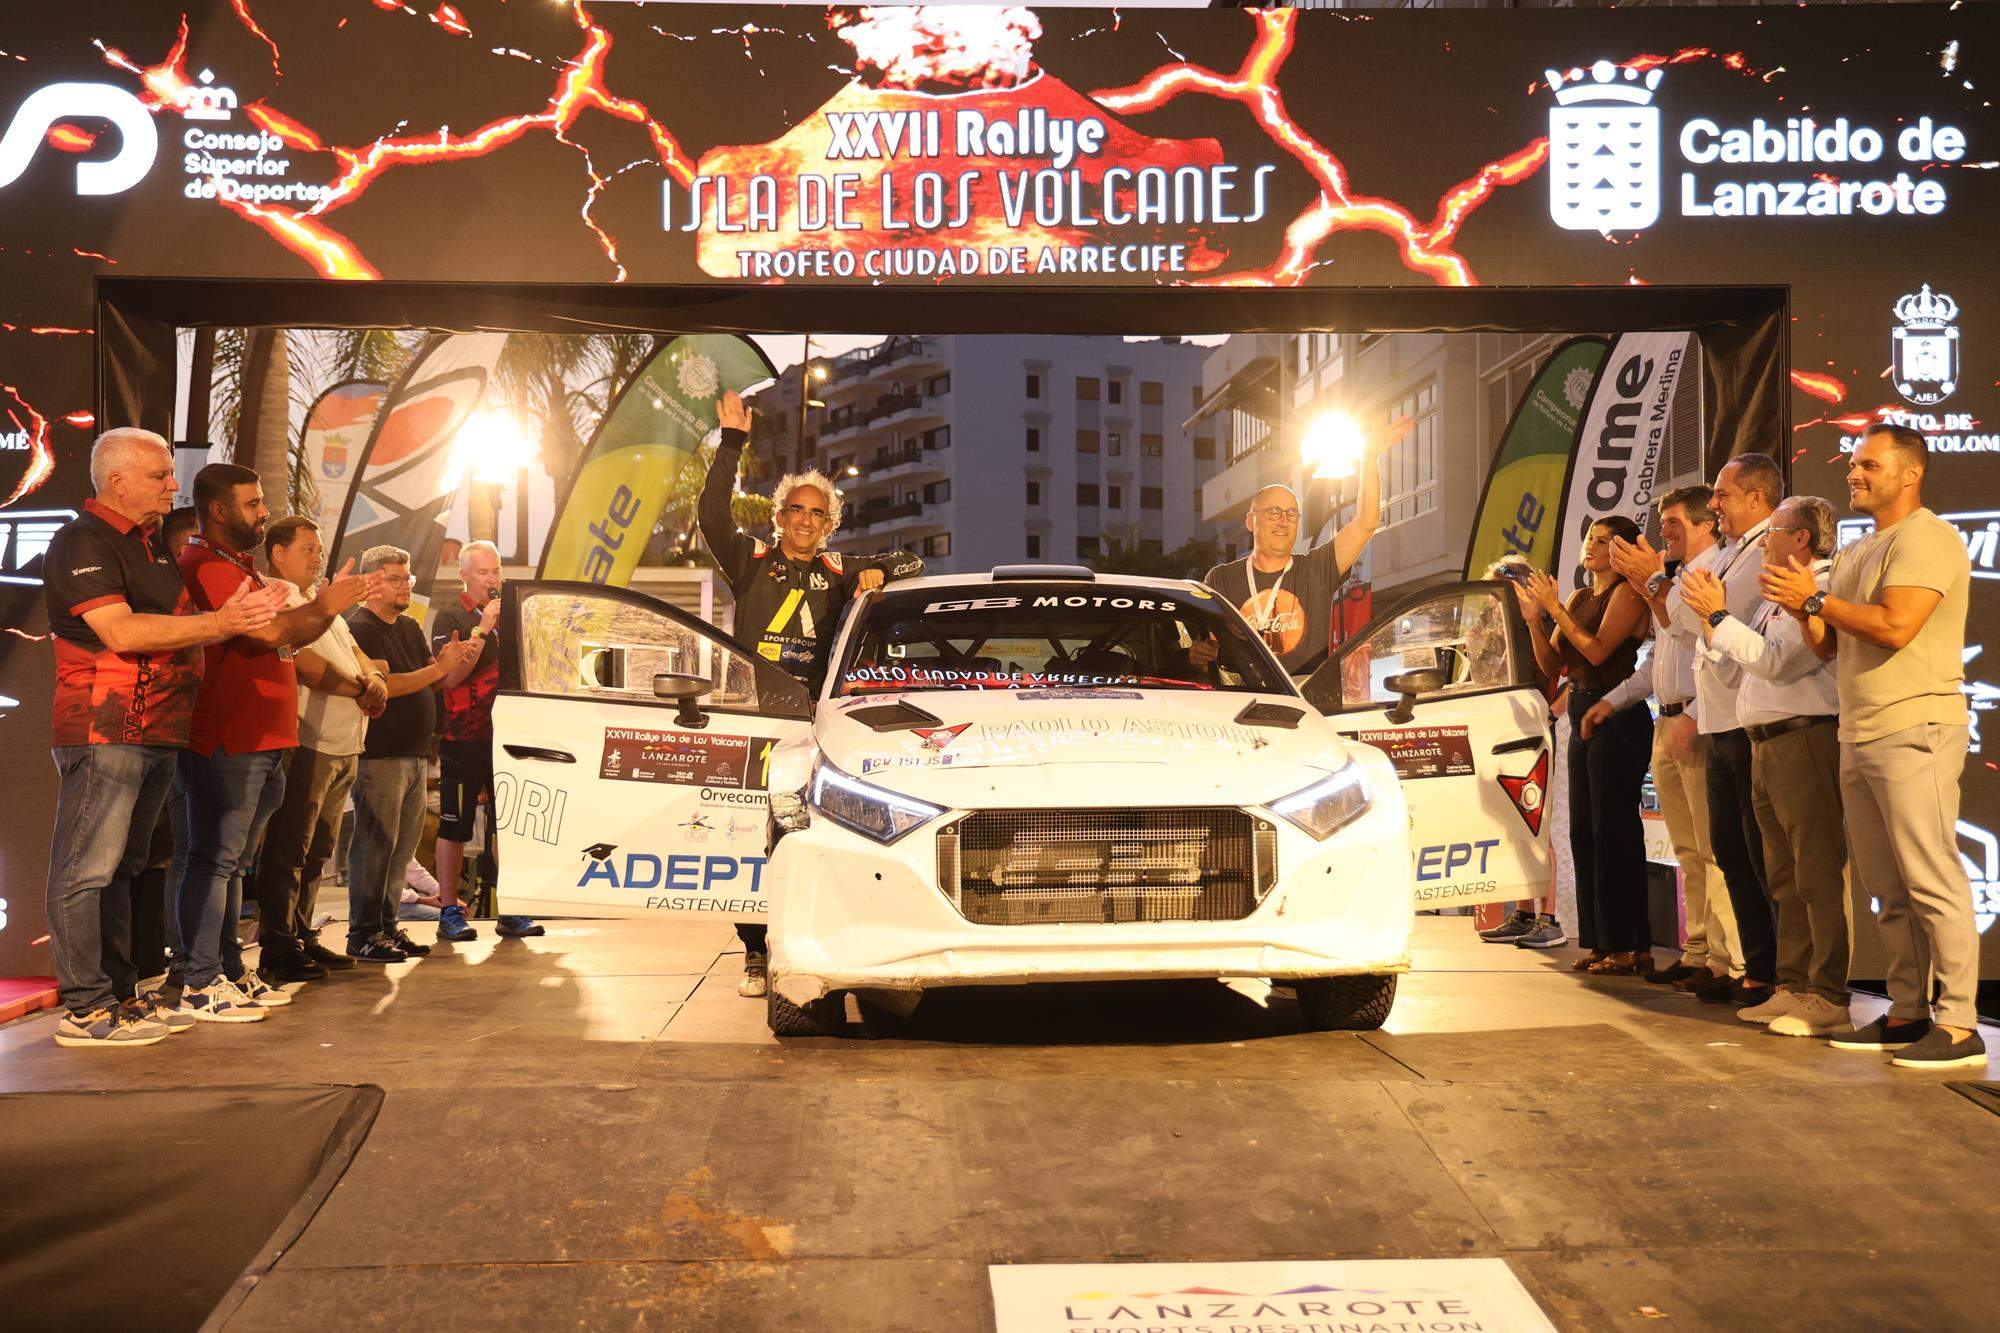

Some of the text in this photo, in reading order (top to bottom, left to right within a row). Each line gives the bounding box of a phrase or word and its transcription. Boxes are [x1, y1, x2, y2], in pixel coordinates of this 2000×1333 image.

[184, 128, 284, 156] Consejo
[825, 108, 1105, 169] XXVII Rallye
[1680, 116, 1967, 164] Cabildo de
[184, 152, 290, 176] Superior
[184, 178, 332, 204] de Deportes
[662, 165, 1276, 232] ISLA DE LOS VOLCANES
[1681, 173, 1947, 216] Lanzarote
[738, 245, 1187, 278] TROFEO CIUDAD DE ARRECIFE
[1537, 389, 1577, 426] Campeona
[1634, 428, 1661, 505] Cabrera
[1651, 349, 1682, 418] Medina
[1944, 413, 1973, 430] DE
[1032, 596, 1176, 612] MOTORS
[764, 635, 790, 643] SPORT
[606, 729, 748, 749] XXVII Rallye Isla de Los Volcanes
[1360, 732, 1383, 742] XXVII
[1383, 731, 1404, 742] Rallye
[1417, 730, 1427, 739] de
[1428, 730, 1439, 738] Los
[1440, 729, 1468, 738] Volcanes
[641, 752, 708, 764] LANZAROTE
[1391, 748, 1443, 759] LANZAROTE
[701, 788, 767, 805] Orvecam
[577, 853, 768, 892] ADEPT
[1413, 839, 1500, 882] EPT
[1414, 881, 1497, 901] ASTENERS
[646, 897, 768, 913] FASTENERS
[1065, 1300, 1470, 1321] LANZAROTE
